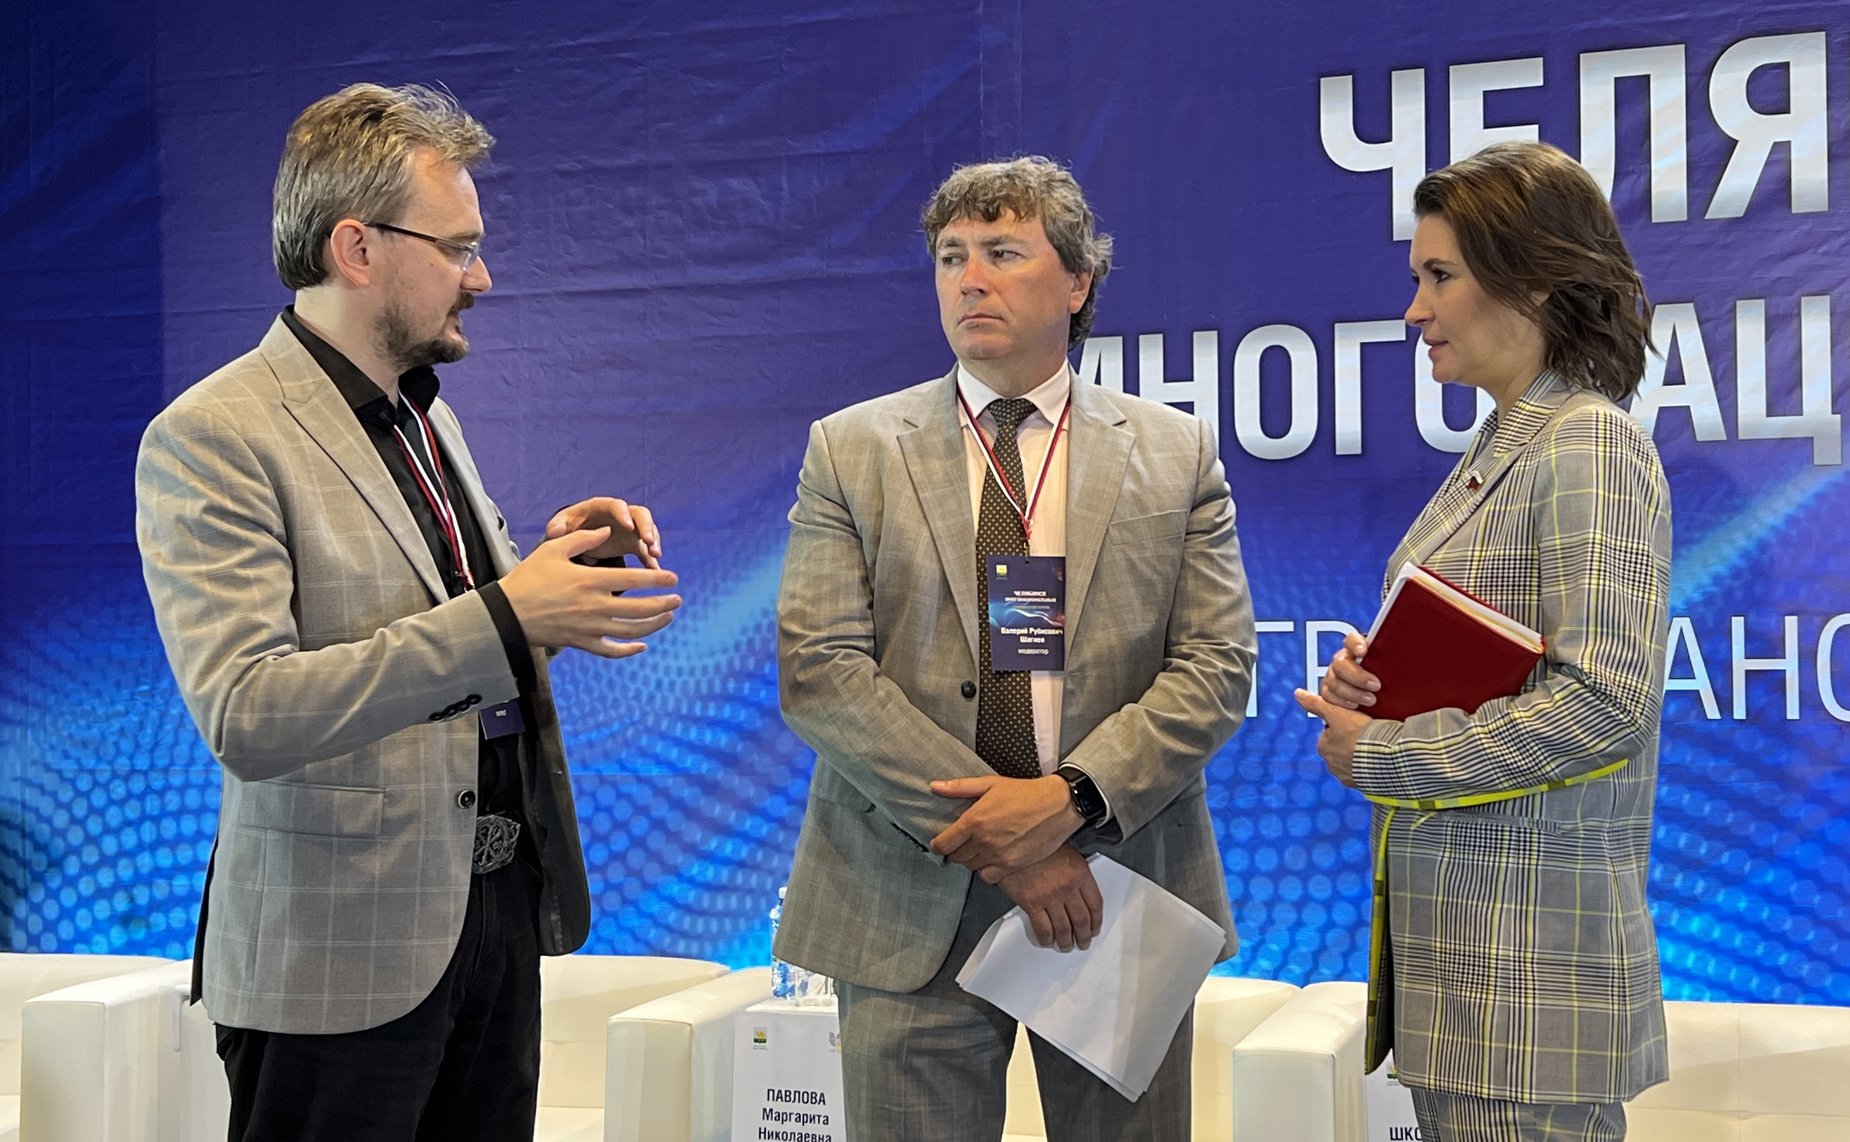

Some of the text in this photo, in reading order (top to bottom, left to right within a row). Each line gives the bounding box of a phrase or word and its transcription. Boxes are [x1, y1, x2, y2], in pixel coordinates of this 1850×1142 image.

[766, 1088, 826, 1106] ПАВЛОВА
[762, 1107, 830, 1127] Маргарита
[758, 1126, 832, 1142] Николаевна
